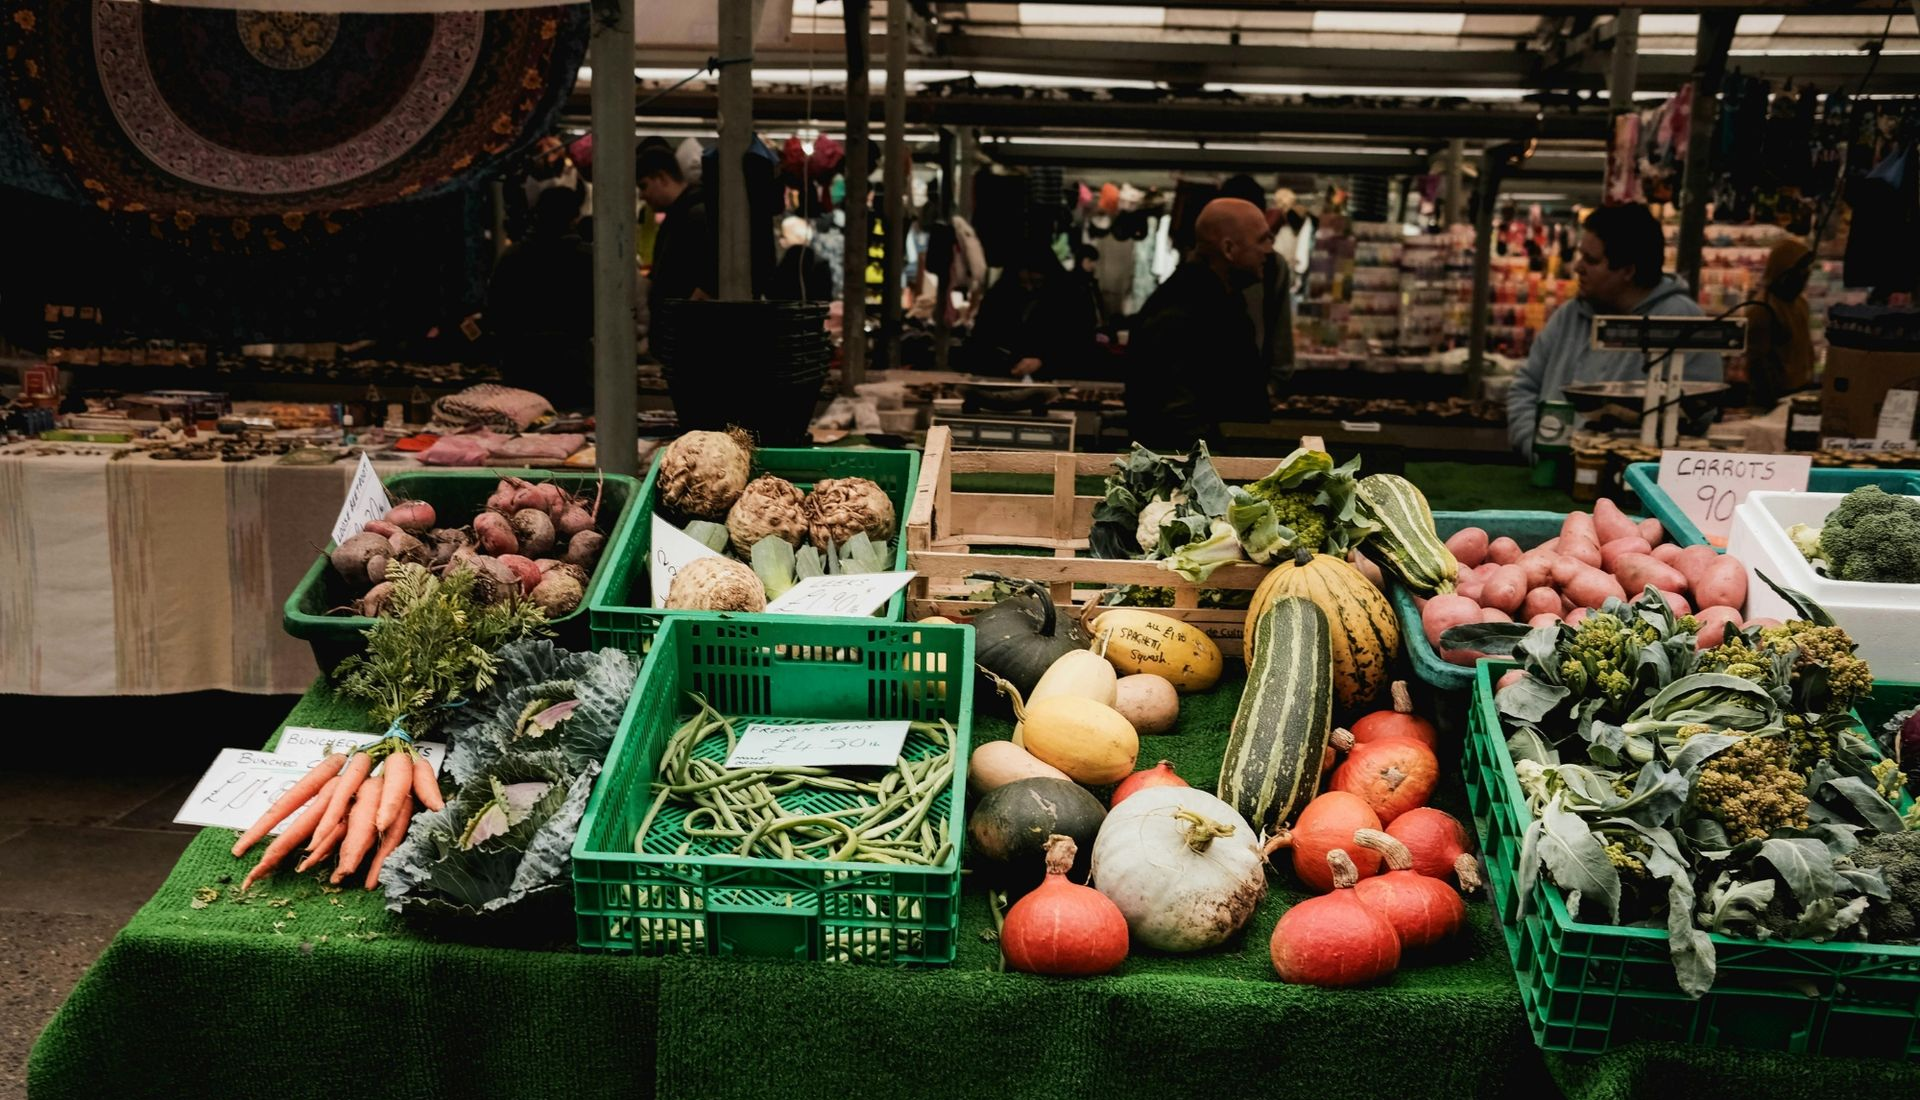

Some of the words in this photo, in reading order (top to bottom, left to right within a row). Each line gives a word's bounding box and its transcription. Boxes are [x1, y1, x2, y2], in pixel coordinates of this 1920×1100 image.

[1677, 457, 1776, 480] CARROTS
[1119, 627, 1162, 650] SPAGHETTI
[749, 726, 814, 735] FRENCH
[819, 724, 874, 733] BEANS
[286, 733, 358, 748] BUNCHED
[237, 752, 298, 768] BUNCHED
